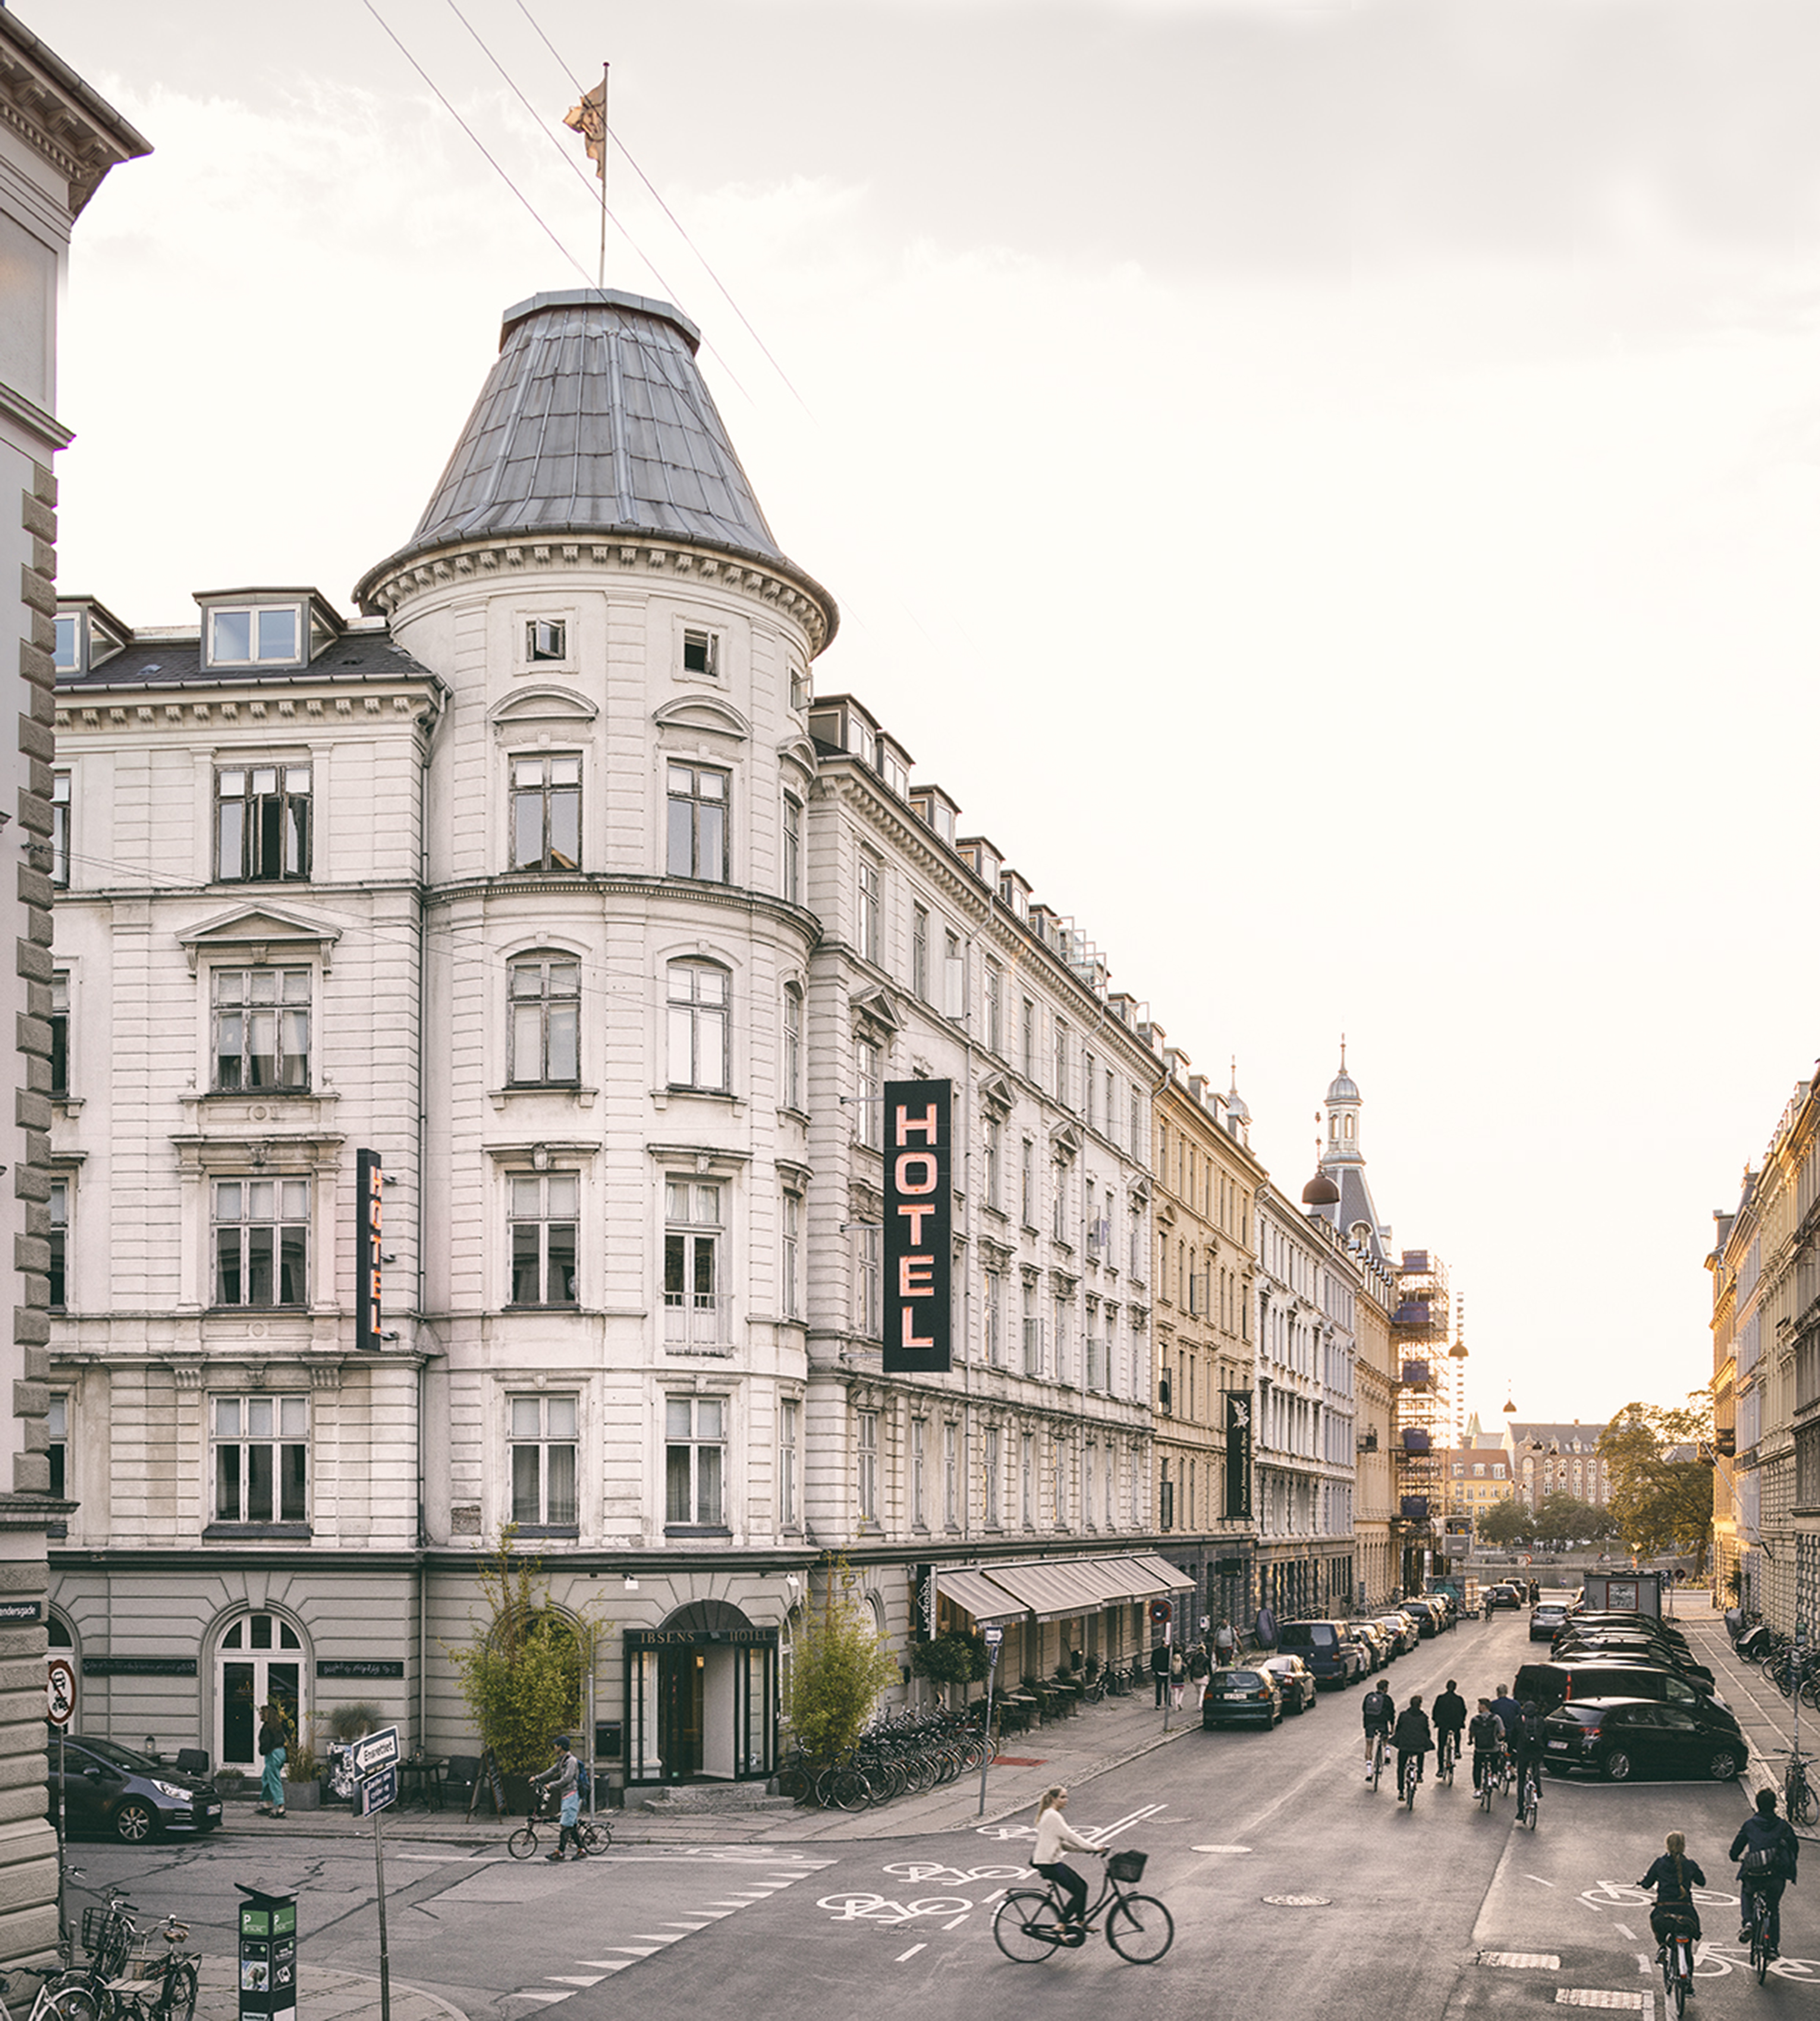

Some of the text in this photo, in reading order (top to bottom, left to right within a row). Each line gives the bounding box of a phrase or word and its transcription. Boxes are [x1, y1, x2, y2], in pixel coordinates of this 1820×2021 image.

[370, 1166, 382, 1333] HOTEL
[895, 1103, 937, 1348] HOTEL
[641, 1631, 768, 1644] IBSENS HOTEL
[244, 1914, 251, 1925] P
